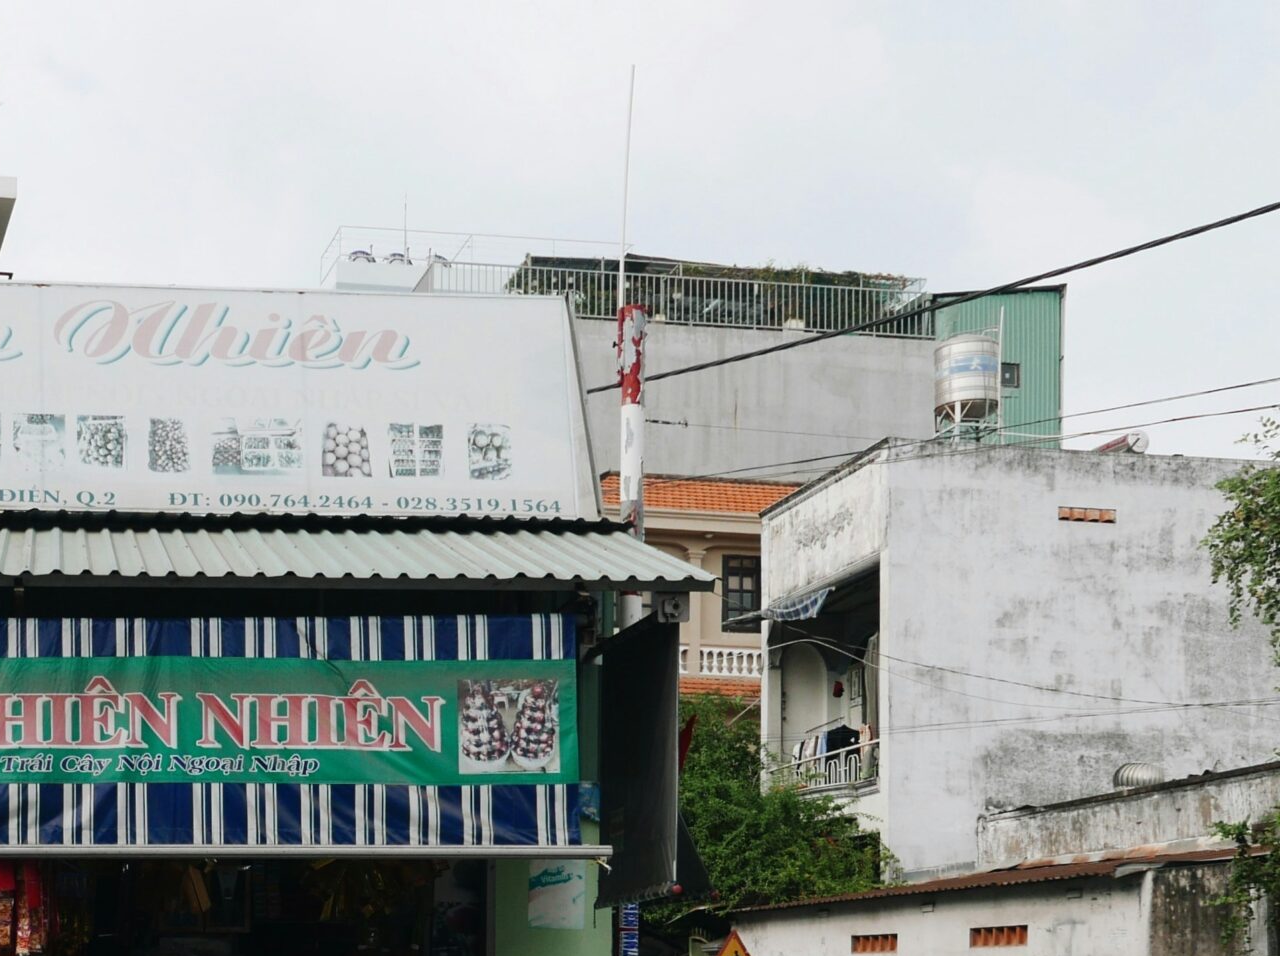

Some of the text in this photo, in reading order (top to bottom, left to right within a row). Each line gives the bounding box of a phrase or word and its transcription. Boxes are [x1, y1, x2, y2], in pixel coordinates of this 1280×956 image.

[76, 490, 116, 507] Q.2
[168, 491, 211, 507] ĐT:
[219, 492, 374, 510] 090.764.2464
[397, 496, 562, 514] 028.3519.1564
[195, 678, 446, 752] NHIÊN
[0, 753, 54, 774] Trái
[59, 754, 112, 776] Cây
[117, 753, 164, 776] Nội
[167, 753, 246, 777] Ngoại
[249, 753, 320, 777] Nhập
